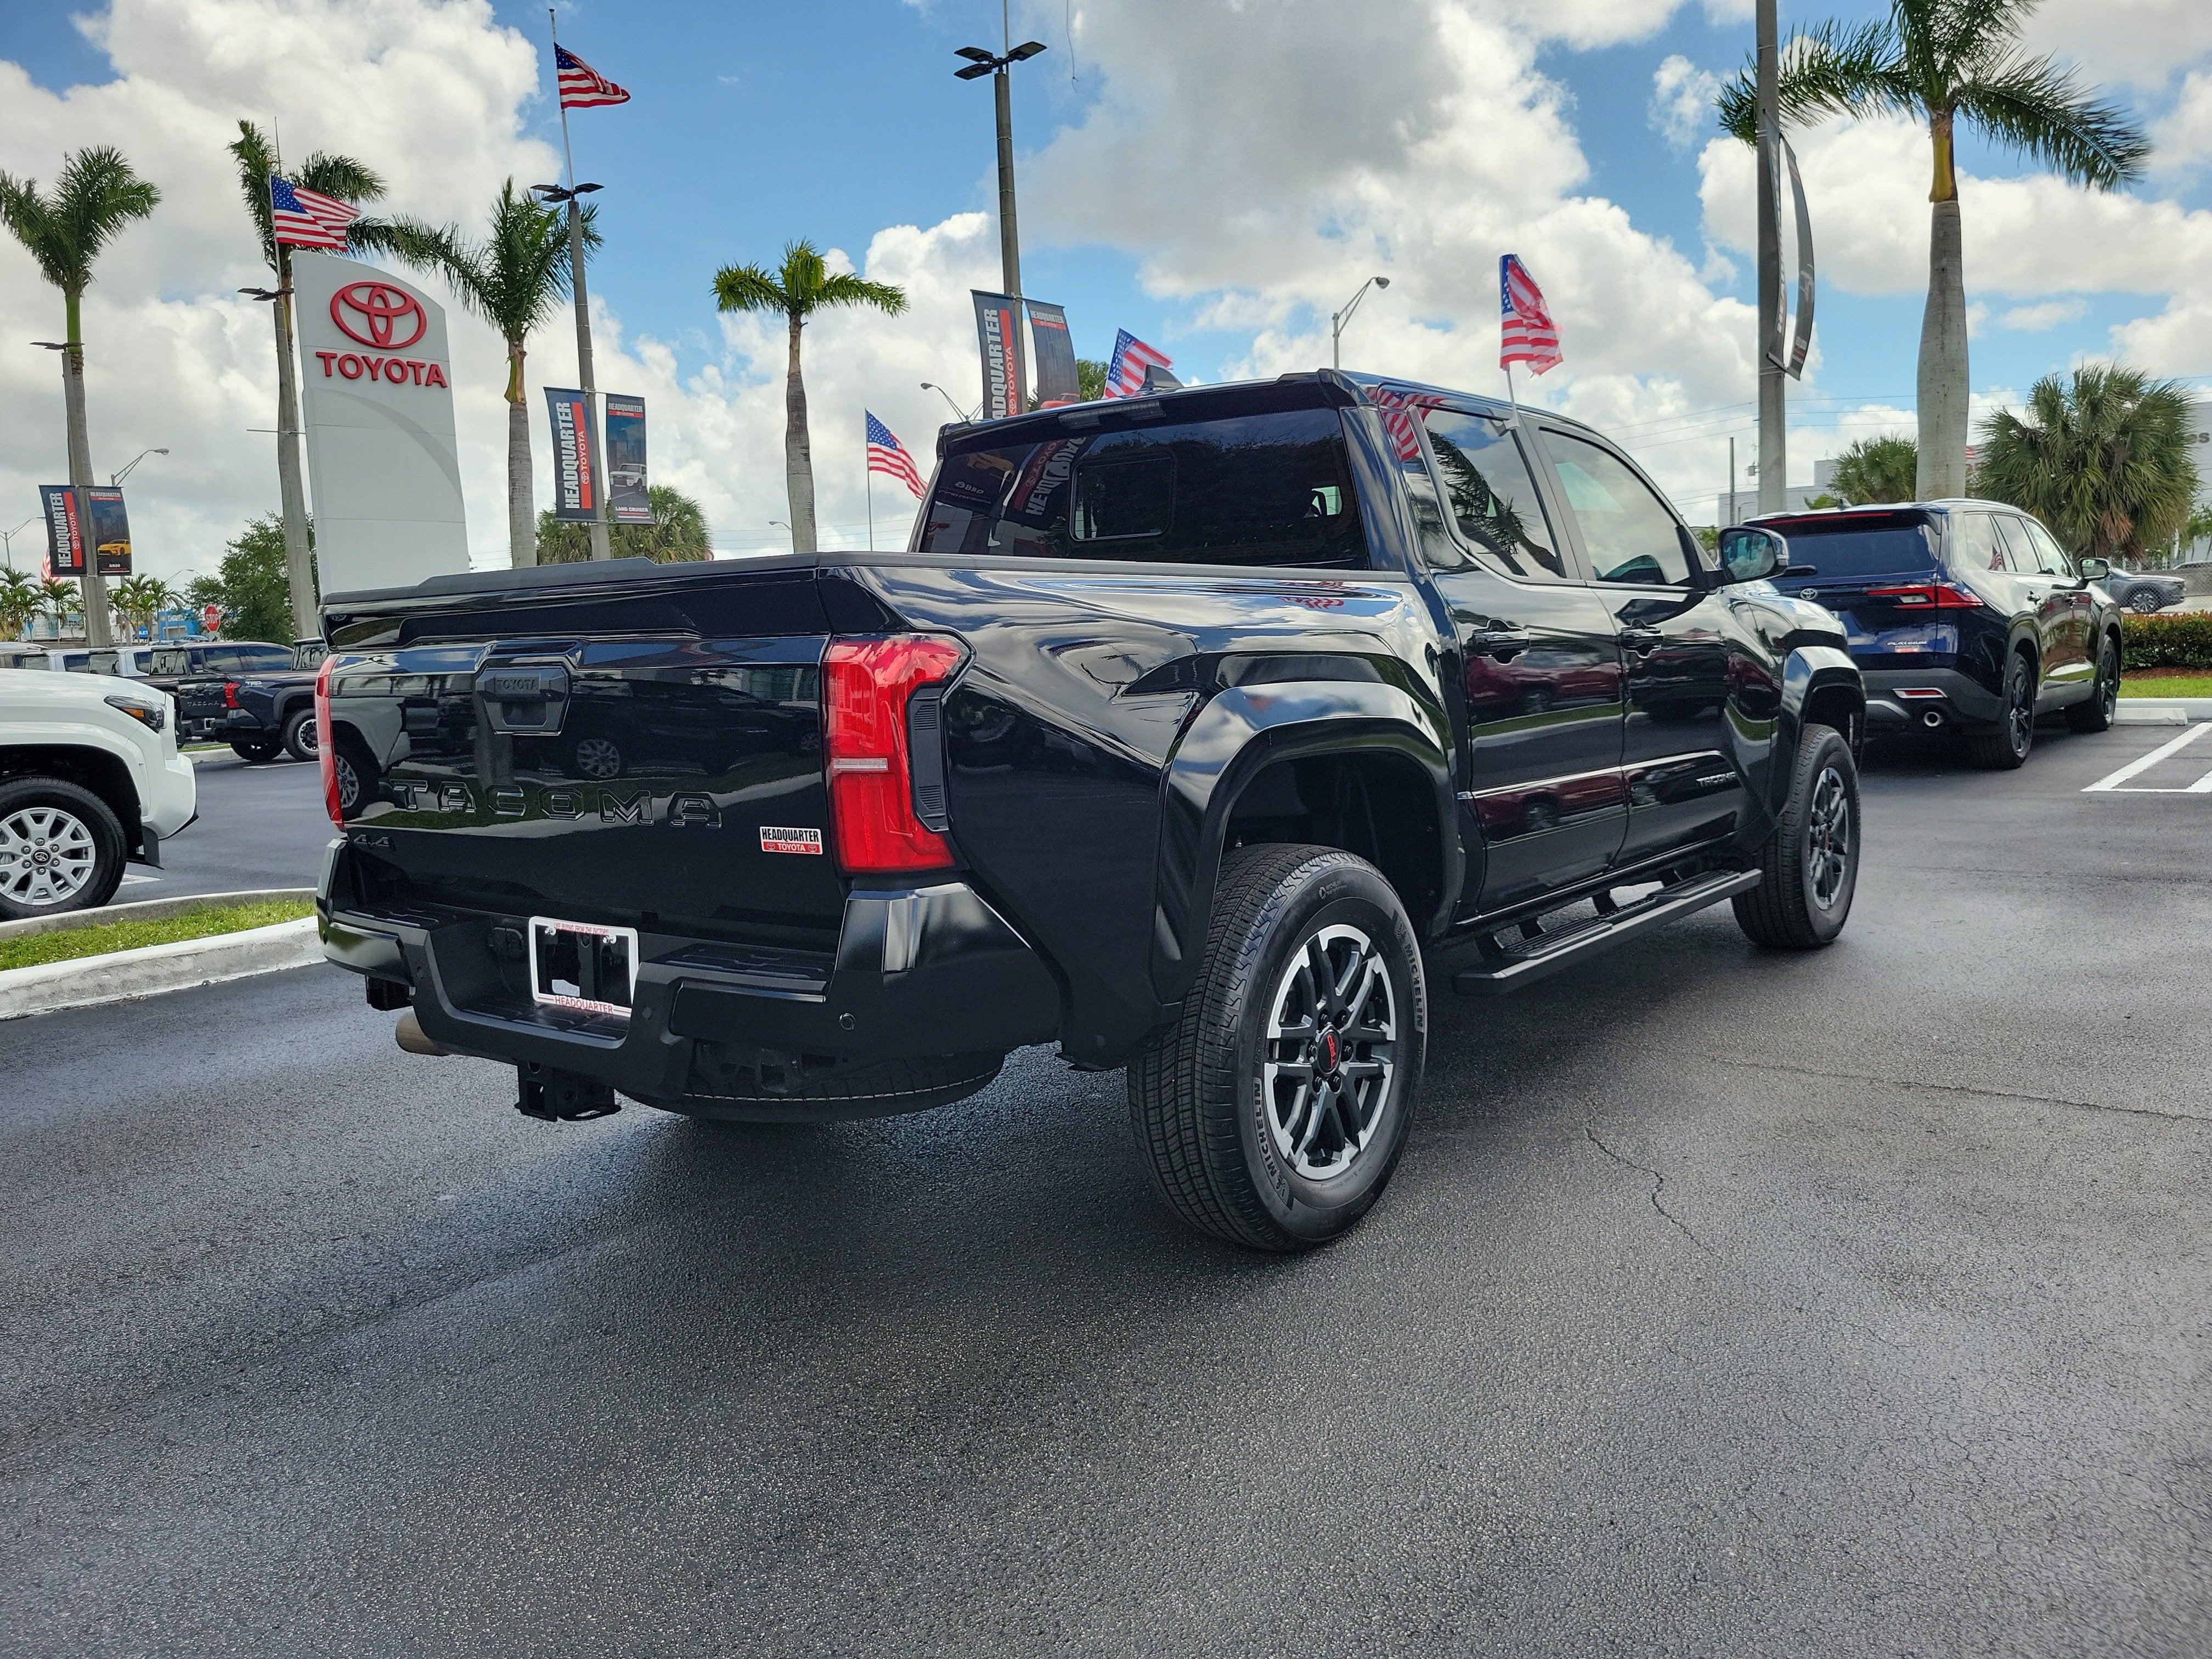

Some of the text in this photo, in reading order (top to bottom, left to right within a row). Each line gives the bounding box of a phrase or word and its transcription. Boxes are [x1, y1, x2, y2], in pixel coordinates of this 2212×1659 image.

[316, 352, 448, 388] TOYOTA
[984, 308, 1007, 420] ADQUARTER
[1006, 346, 1015, 398] TOYOTA
[608, 403, 643, 413] HEADQUARTER
[556, 402, 580, 509] HEADQUARTER
[578, 431, 588, 470] TOYOTA
[49, 492, 72, 567] HEADQUARTER
[69, 512, 78, 539] TOYOTA
[206, 613, 219, 624] STOP
[497, 679, 538, 691] TOYOTA
[390, 778, 723, 828] TACOMA
[761, 828, 819, 842] HEADQUARTER
[777, 843, 806, 851] TOYOTA
[1403, 943, 1424, 1028] MICHELIN
[555, 996, 613, 1013] HEADQUARTER
[1253, 1082, 1278, 1179] MICHELIN
